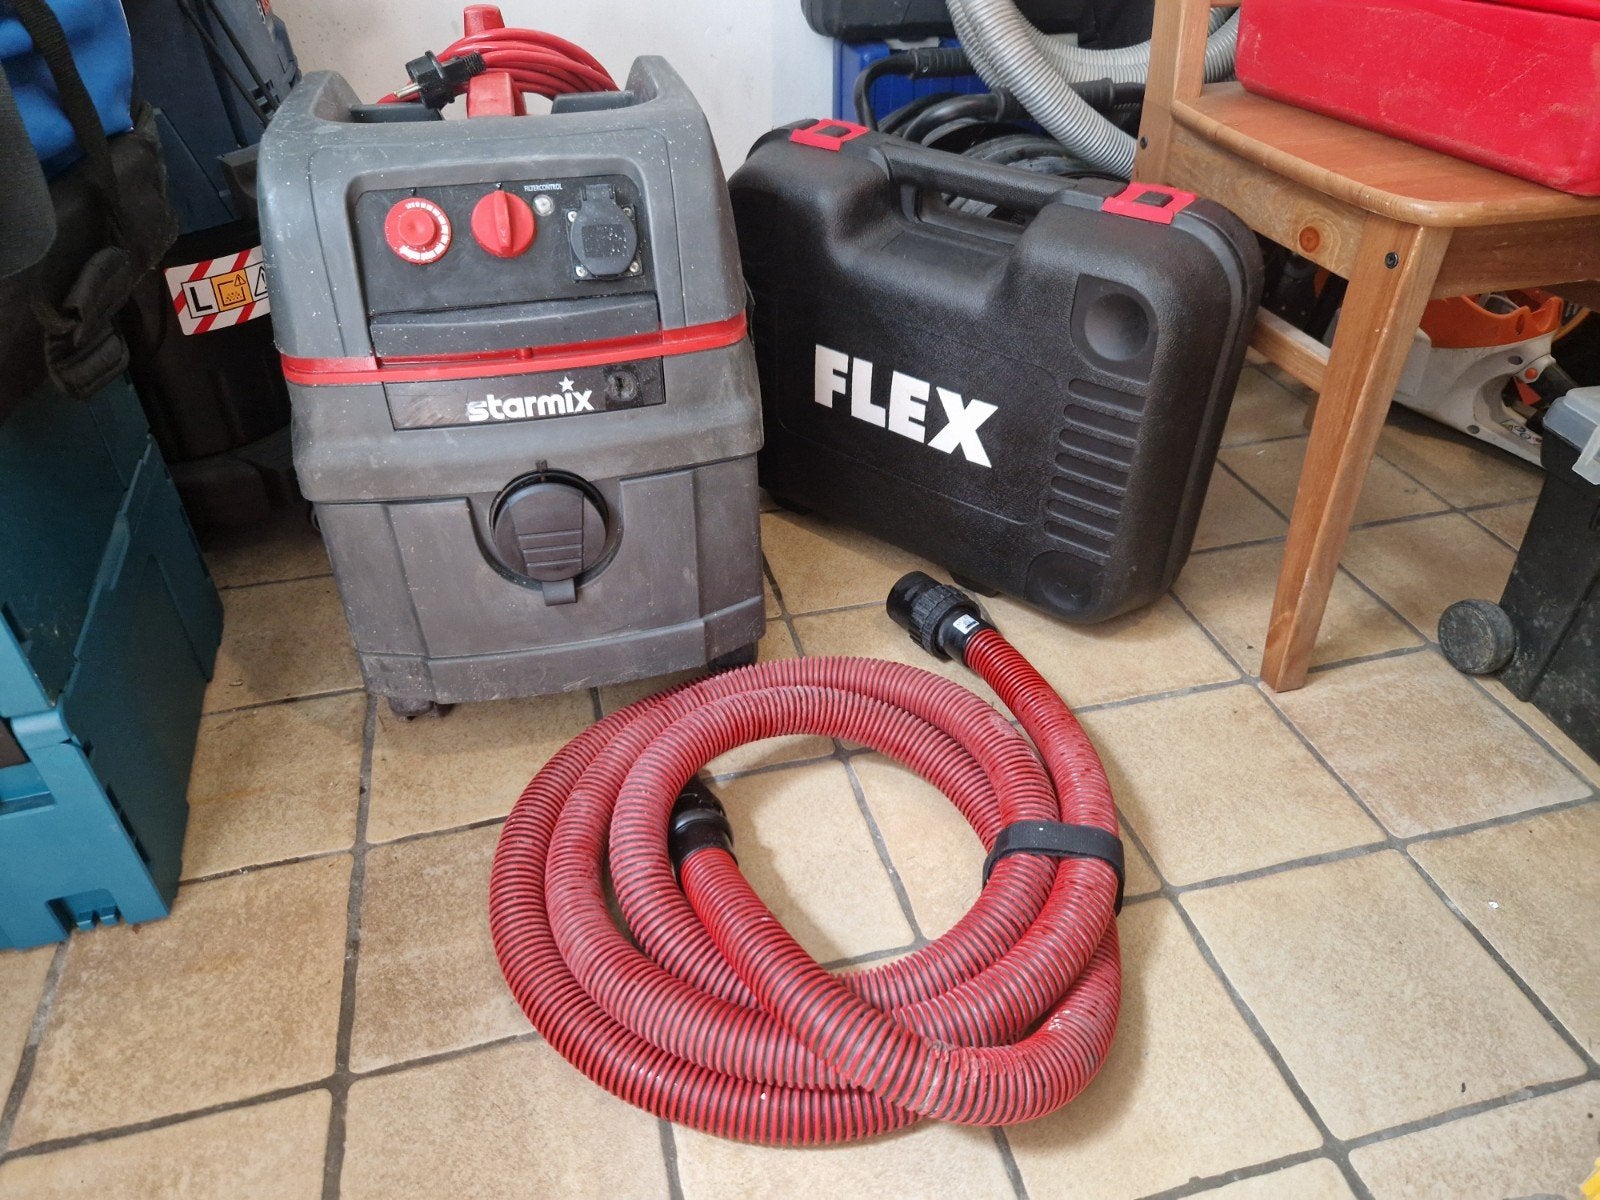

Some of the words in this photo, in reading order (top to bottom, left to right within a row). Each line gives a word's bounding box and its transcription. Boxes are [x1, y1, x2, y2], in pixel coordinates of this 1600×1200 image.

[190, 286, 213, 312] L
[467, 377, 595, 422] starmix
[815, 345, 999, 468] FLEX
